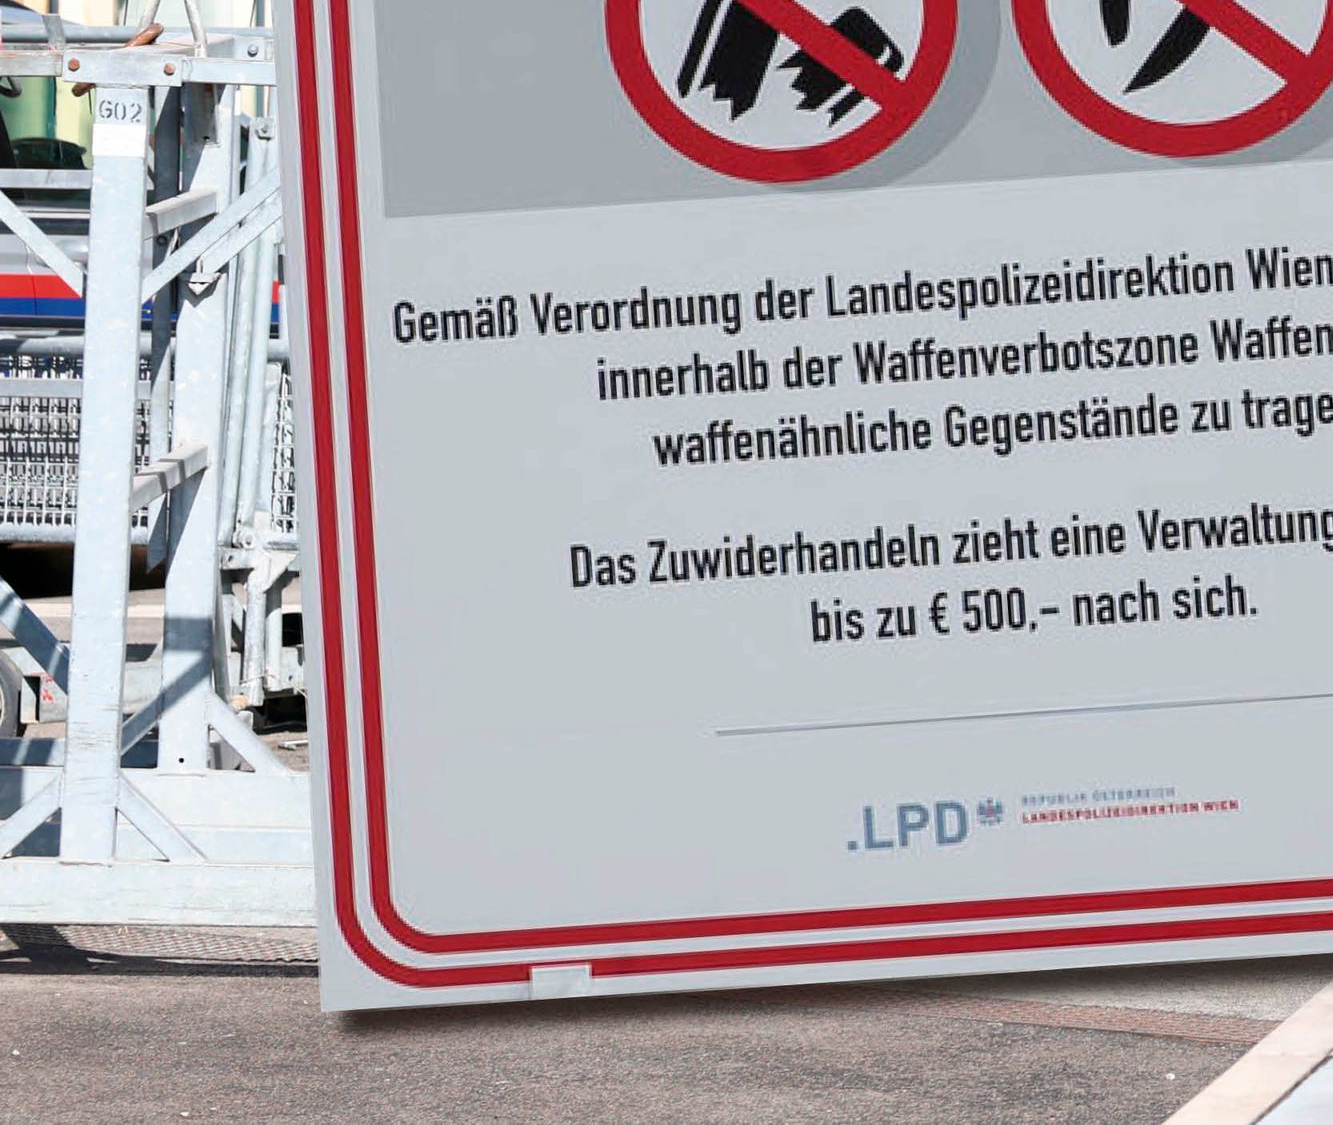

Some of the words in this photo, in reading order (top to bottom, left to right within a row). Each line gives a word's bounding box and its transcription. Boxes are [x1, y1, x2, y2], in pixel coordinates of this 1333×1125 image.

[394, 295, 519, 344] Gemäß
[529, 285, 742, 336] Verordnung
[754, 279, 815, 322] der
[825, 252, 1235, 321] Landespolizeidirektion
[597, 348, 769, 401] innerhalb
[782, 345, 843, 390] der
[852, 331, 1199, 385] Waffenverbotszone
[653, 408, 932, 466] waffenähnliche
[945, 392, 1179, 457] Gegenstände
[1190, 399, 1230, 433] zu
[570, 544, 636, 590] Das
[647, 523, 940, 583] Zuwiderhandeln
[951, 518, 1040, 564] zieht
[1050, 514, 1126, 557] eine
[811, 598, 865, 643] bis
[876, 605, 917, 639] zu
[928, 591, 950, 634] €
[1072, 578, 1160, 627] nach
[1172, 574, 1257, 620] sich.
[847, 799, 969, 851] .LPD
[1022, 792, 1087, 806] REPUBLIK
[1022, 802, 1199, 824] LANDESPOLIZEIDIREKTION
[1203, 799, 1239, 812] WIEN
